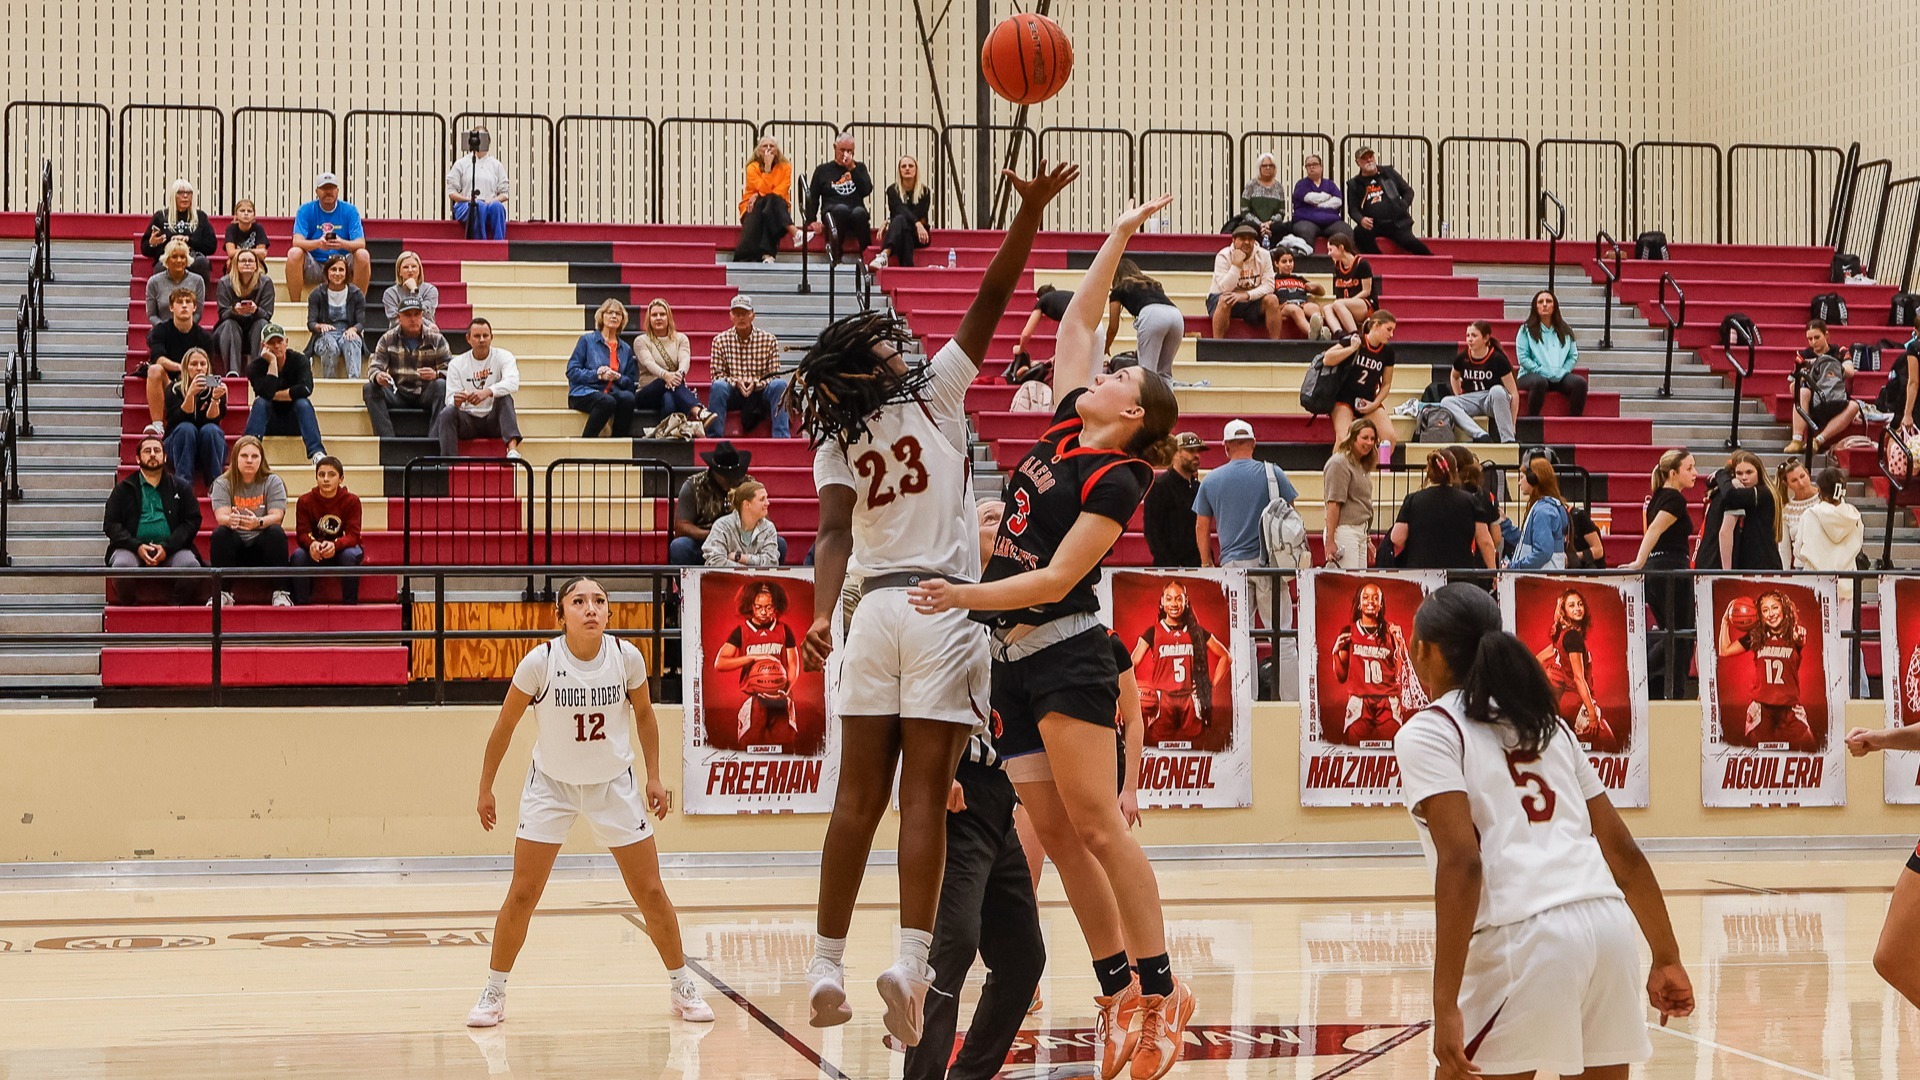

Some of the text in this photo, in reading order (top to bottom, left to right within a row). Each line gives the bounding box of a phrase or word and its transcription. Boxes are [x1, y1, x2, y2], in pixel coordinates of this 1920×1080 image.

[1357, 369, 1369, 385] 2
[1463, 368, 1493, 380] ALEDO
[1472, 380, 1486, 391] 11
[853, 435, 931, 511] 23
[1018, 455, 1056, 495] ALEDO
[1006, 486, 1031, 538] 3
[1173, 657, 1186, 683] 5
[1363, 658, 1383, 684] 10
[1764, 658, 1785, 685] 12
[554, 684, 621, 708] ROUGH RIDERS
[573, 712, 607, 742] 12
[706, 760, 823, 795] FREEMAN
[1137, 756, 1215, 790] MCNEIL
[1506, 748, 1556, 823] 5
[1721, 756, 1824, 789] AGUILERA
